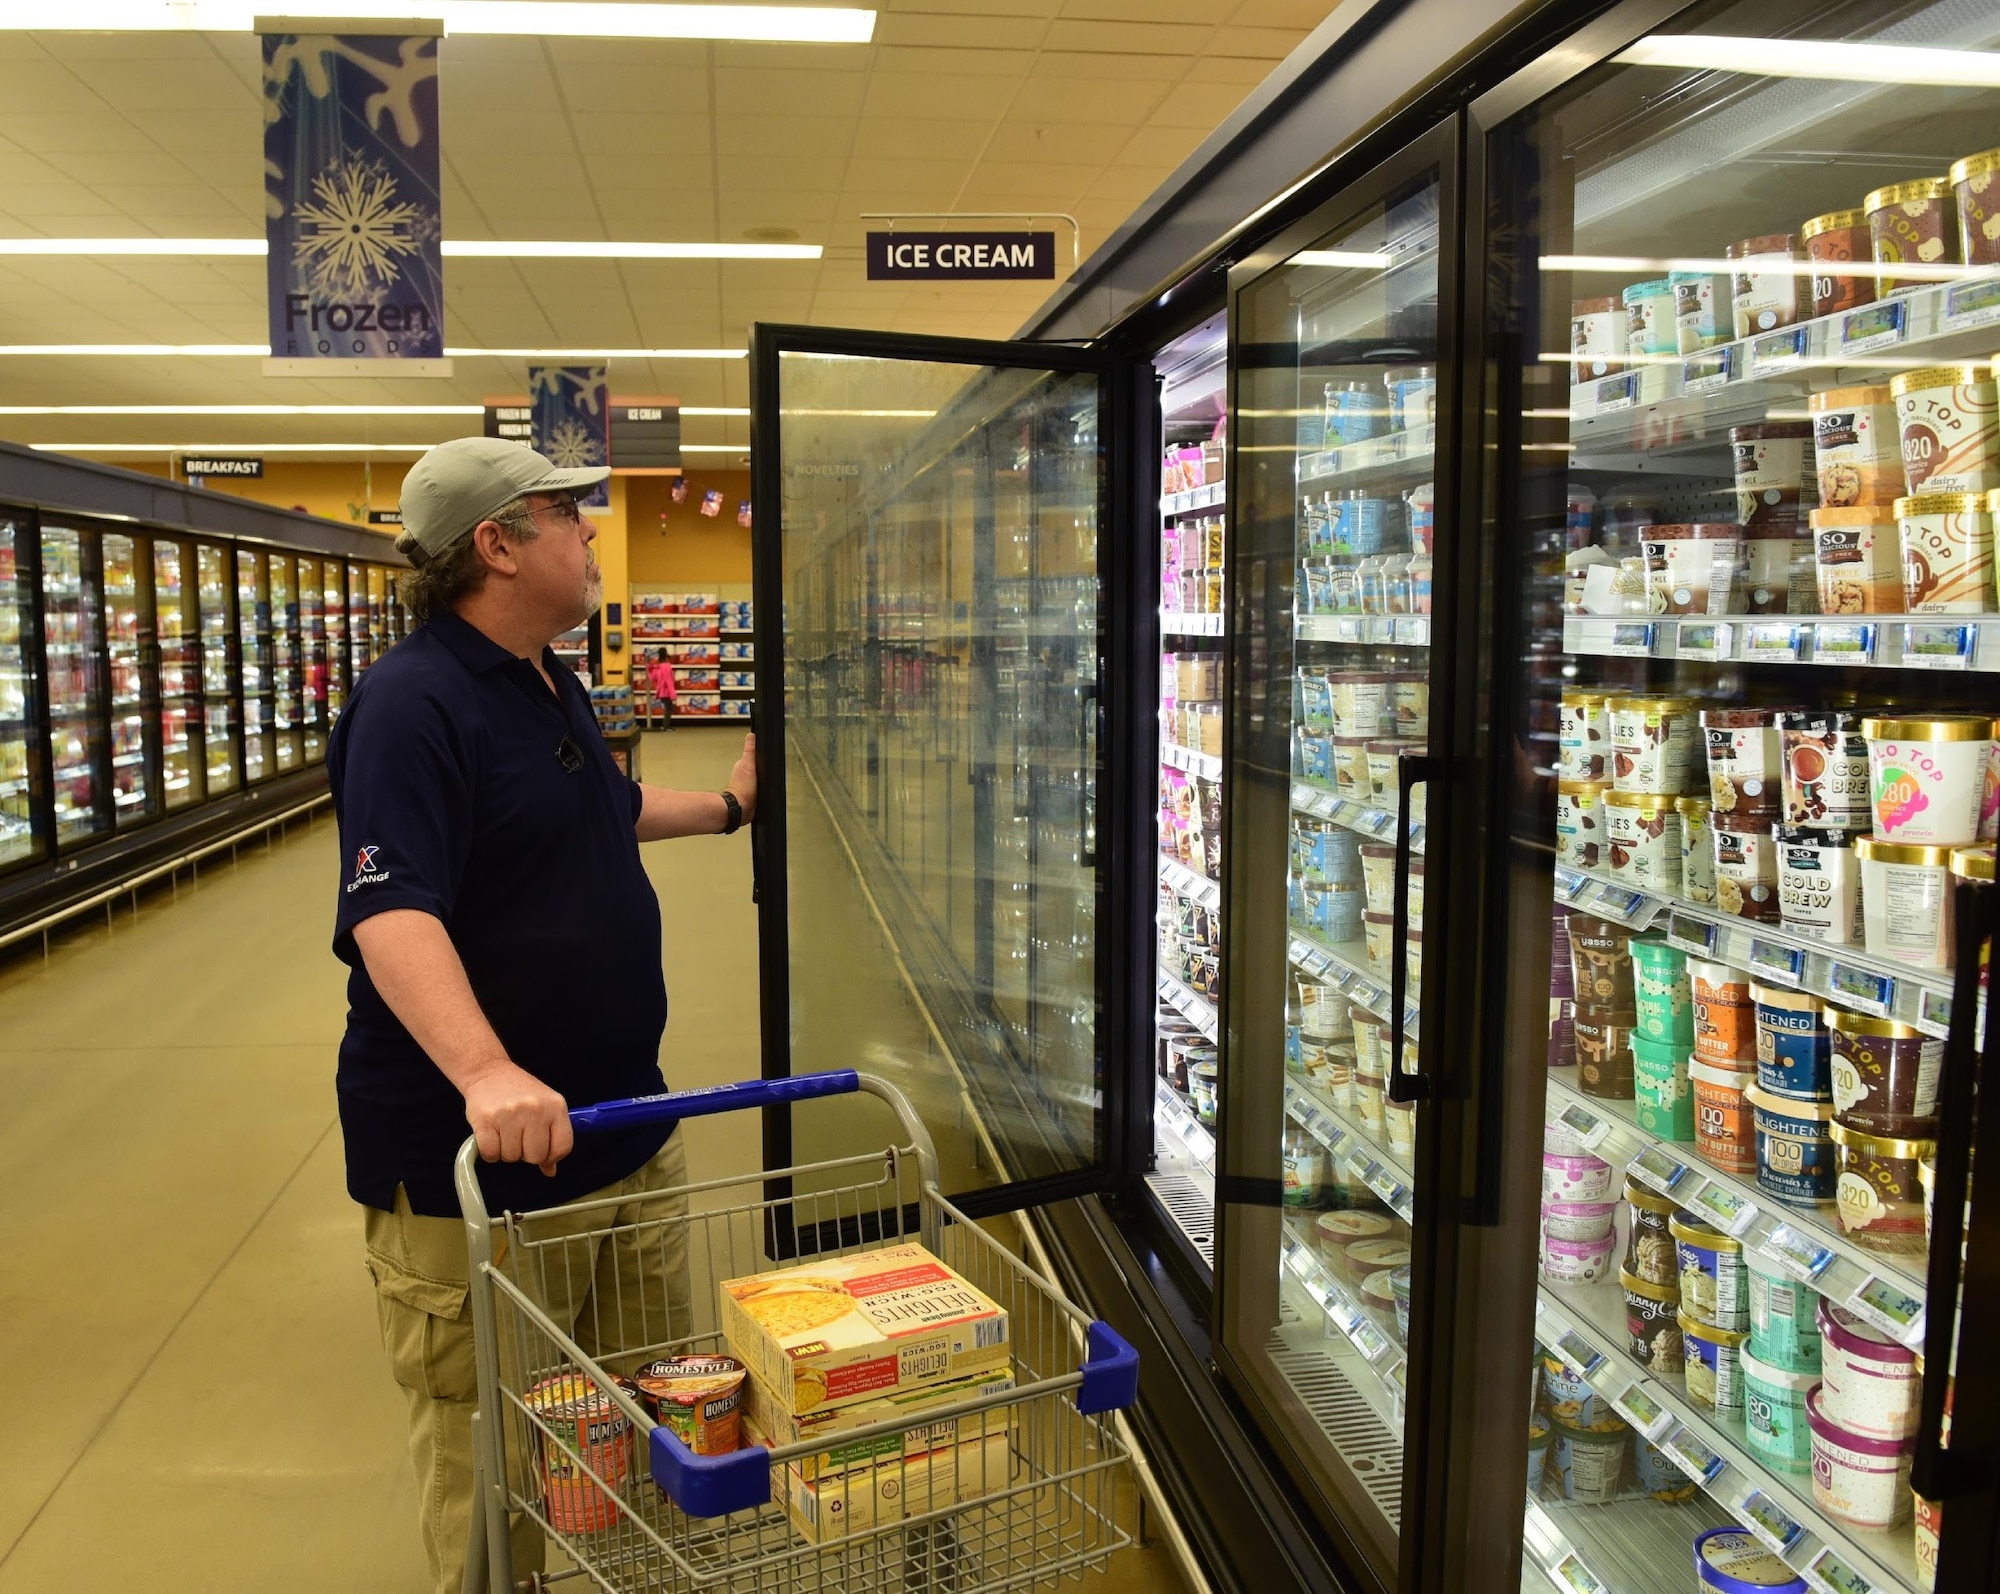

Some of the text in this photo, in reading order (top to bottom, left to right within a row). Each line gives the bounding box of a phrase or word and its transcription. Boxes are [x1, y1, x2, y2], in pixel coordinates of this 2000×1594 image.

[1888, 214, 1920, 242] TOP
[887, 244, 1034, 268] ICE CREAM
[286, 295, 429, 333] Frozen
[287, 340, 431, 354] FOODS
[628, 409, 662, 420] ICE CREAM
[1820, 416, 1842, 428] SO
[1927, 400, 1962, 431] TOP
[1904, 436, 1931, 462] 320
[186, 461, 259, 474] BREAKFAST
[1823, 533, 1846, 545] SO
[1921, 527, 1952, 559] TOP
[1910, 749, 1944, 781] TOP
[1783, 872, 1830, 891] COLD
[1888, 870, 1916, 878] Nutrition
[1783, 888, 1831, 908] BREW
[1581, 937, 1613, 947] yasso
[1643, 966, 1677, 976] yasso
[1700, 1037, 1728, 1051] BUTTER
[1851, 1040, 1882, 1075] TOP
[1777, 1071, 1785, 1079] &
[1700, 1105, 1724, 1125] 100
[1711, 1141, 1745, 1154] BUTTER
[1772, 1140, 1800, 1160] 100
[1772, 1157, 1800, 1171] CALORIES
[1761, 1168, 1811, 1189] Brownies &
[1869, 1160, 1901, 1194] TOP
[1785, 1186, 1814, 1197] DOUGH
[1842, 1183, 1869, 1209] 320
[1861, 1233, 1889, 1244] protein
[1879, 1290, 1888, 1299] $
[870, 1292, 976, 1324] DELIGHTS
[921, 1308, 964, 1323] Jimmy Dean
[794, 1342, 824, 1355] NEW!
[655, 1362, 731, 1374] HOMESTYLE
[901, 1352, 947, 1377] DELIGHTS
[1749, 1395, 1771, 1420] 80
[1813, 1451, 1830, 1479] 70
[1831, 1566, 1839, 1574] $
